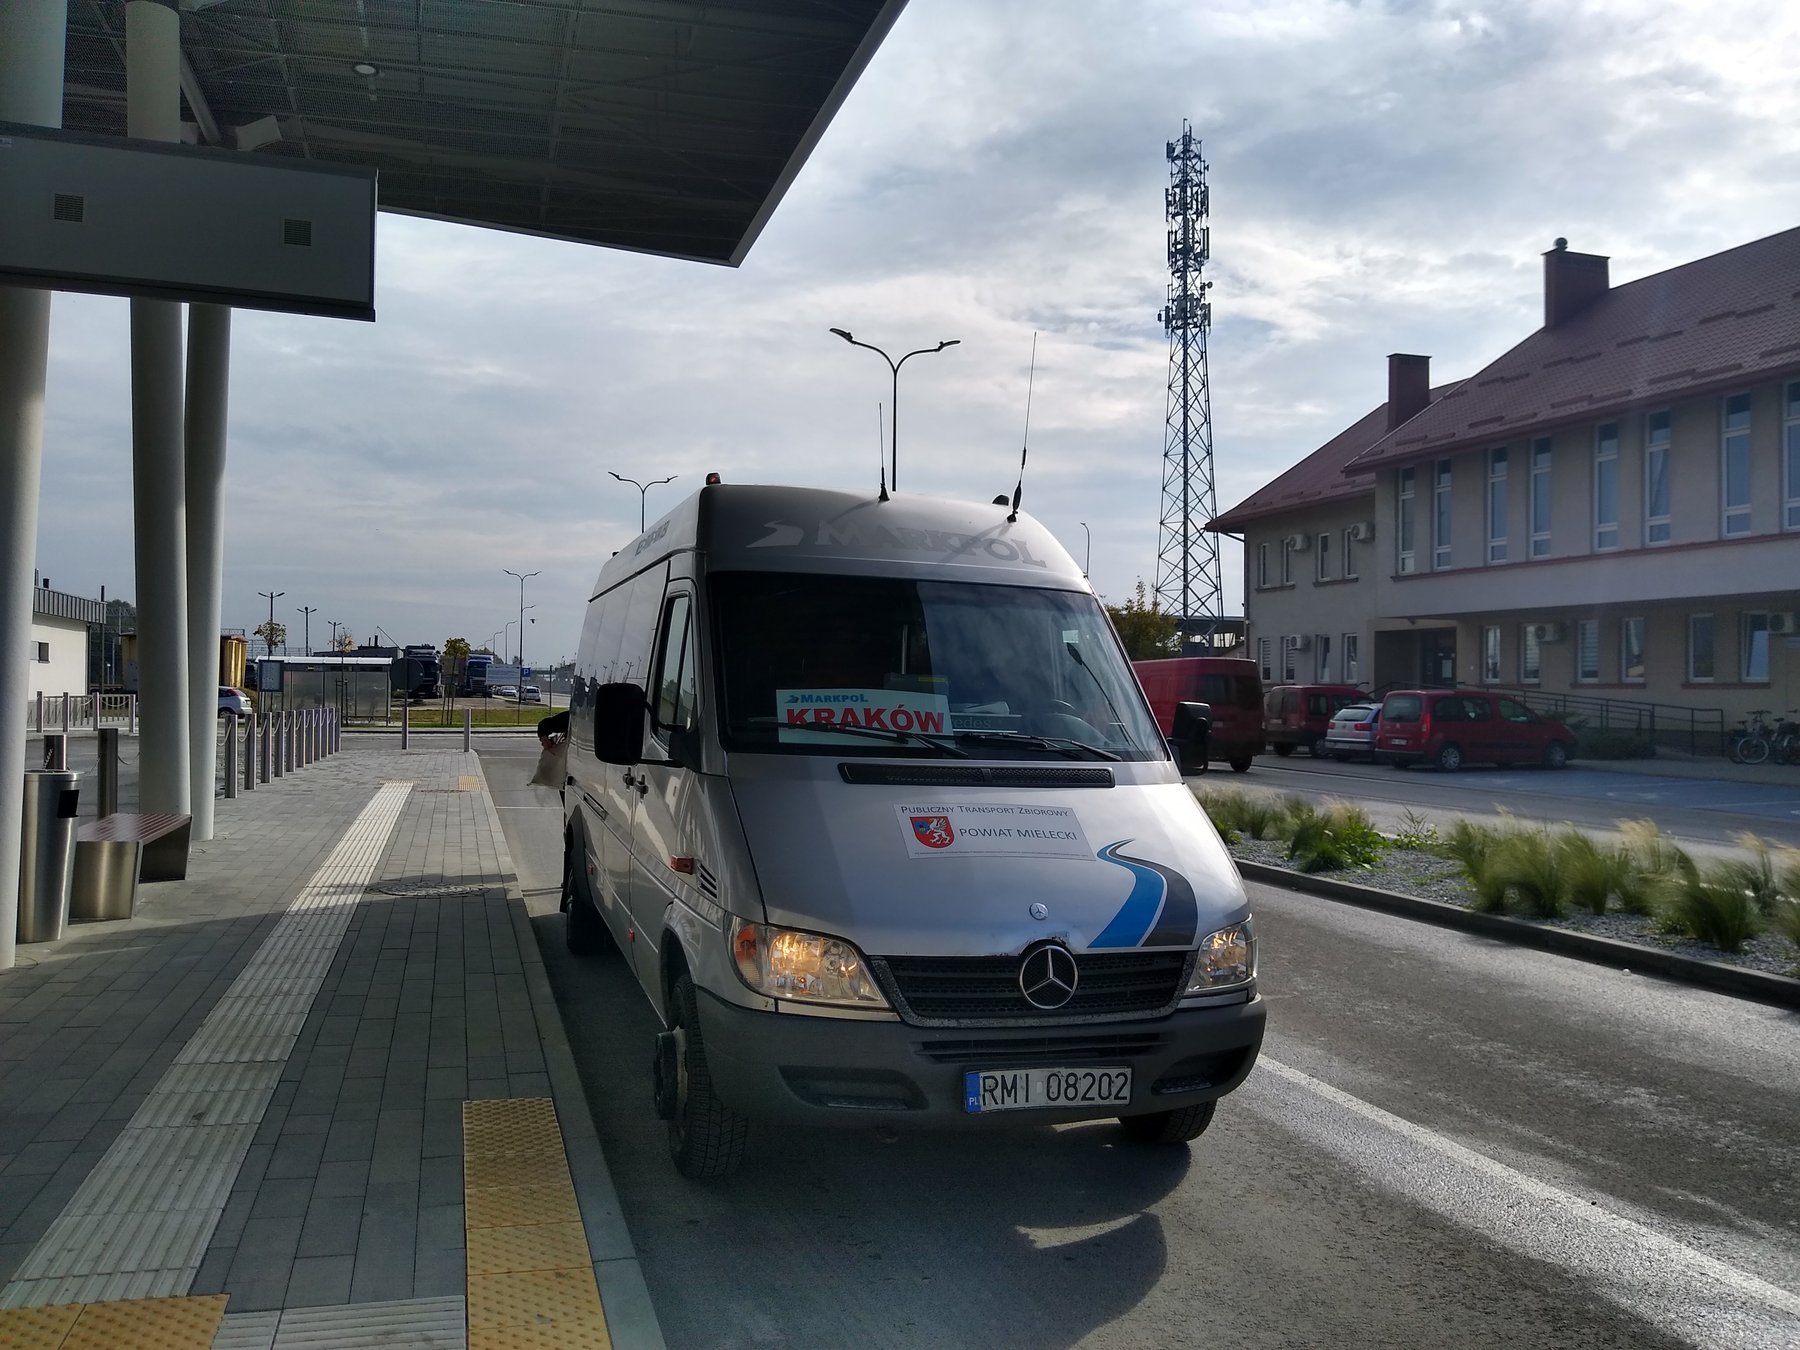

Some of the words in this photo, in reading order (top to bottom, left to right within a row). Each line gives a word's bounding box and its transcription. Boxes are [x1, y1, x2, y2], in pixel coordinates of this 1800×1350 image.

[815, 519, 1047, 568] MARKPOL
[801, 694, 868, 703] MARKPOL
[786, 704, 945, 733] KRAKÓW
[957, 806, 1014, 814] TRANSPORT
[1018, 807, 1068, 816] ZBIOROWY
[959, 828, 1013, 838] POWIAT
[1016, 829, 1077, 840] MIELECKI
[982, 1074, 1029, 1106] RMI
[1046, 1072, 1129, 1101] 08202
[968, 1097, 979, 1106] PL
